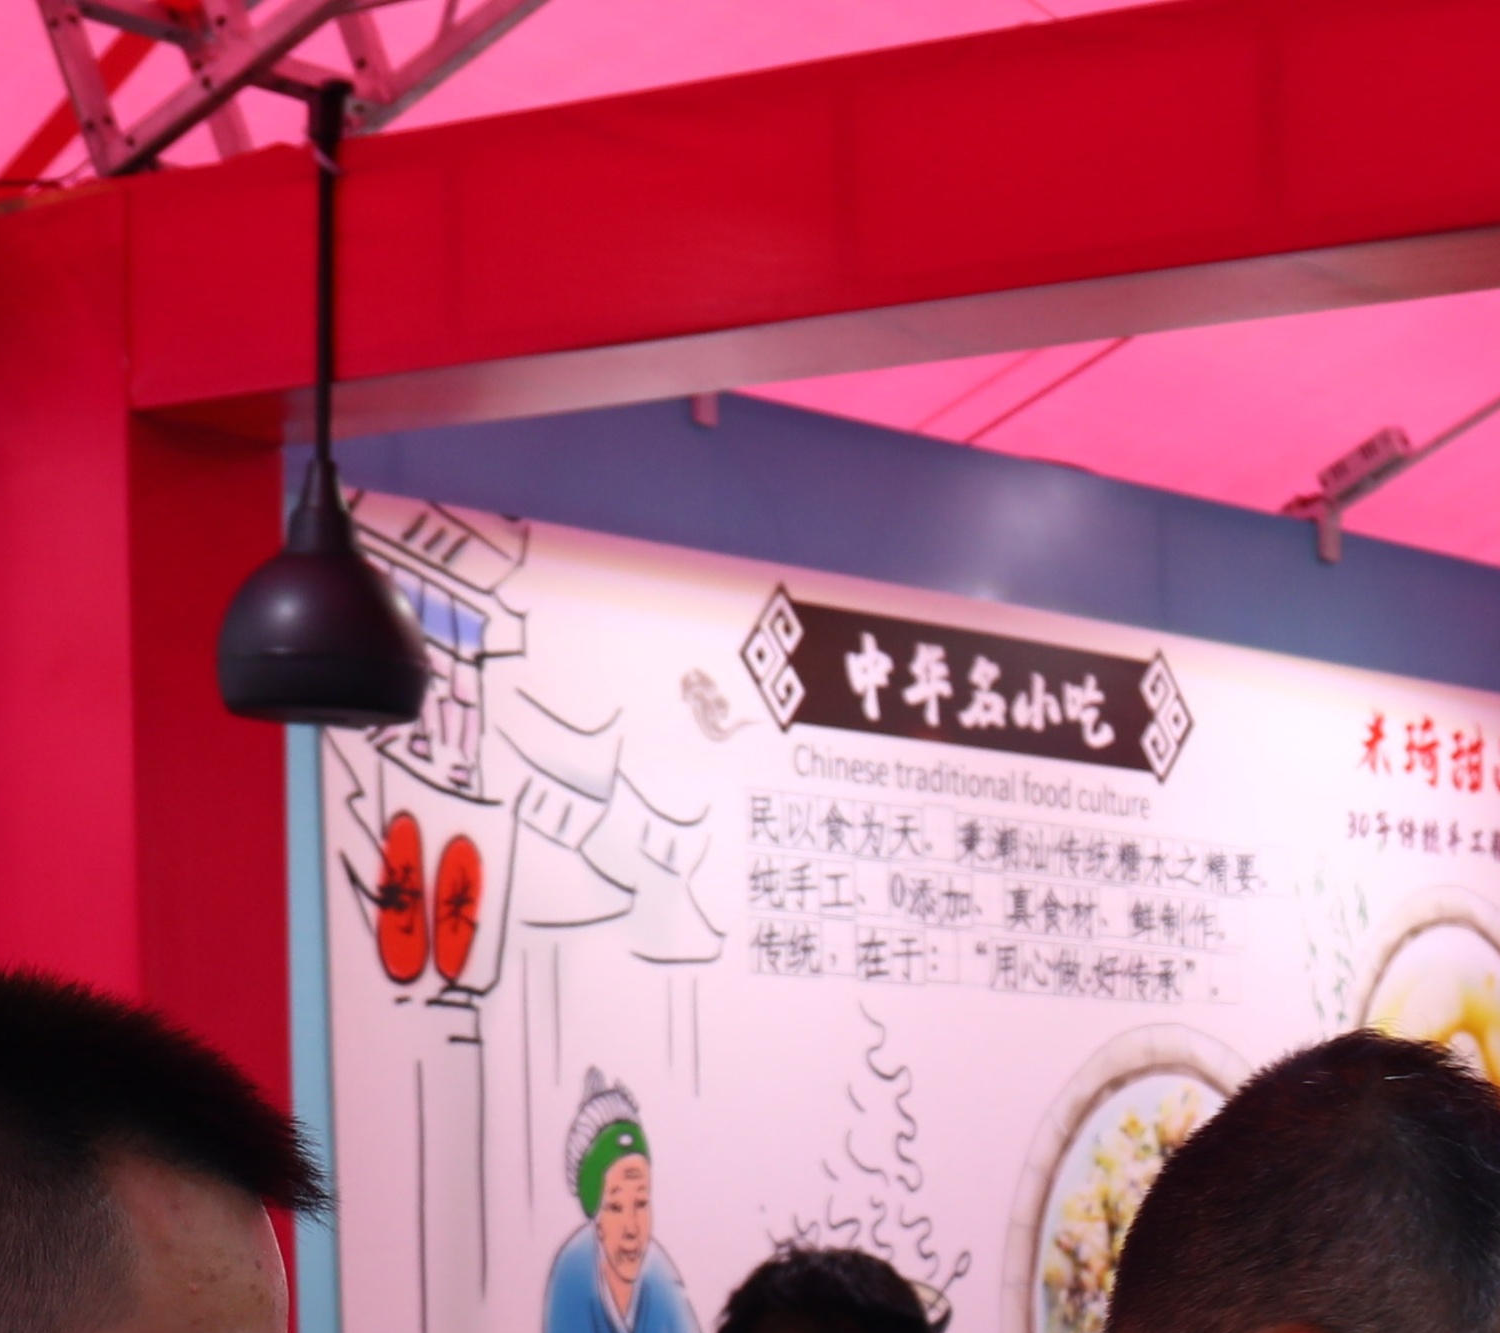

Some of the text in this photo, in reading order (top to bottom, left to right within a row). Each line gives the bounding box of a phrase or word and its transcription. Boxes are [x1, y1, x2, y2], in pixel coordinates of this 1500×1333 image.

[793, 744, 1150, 819] Chinese traditional food culture
